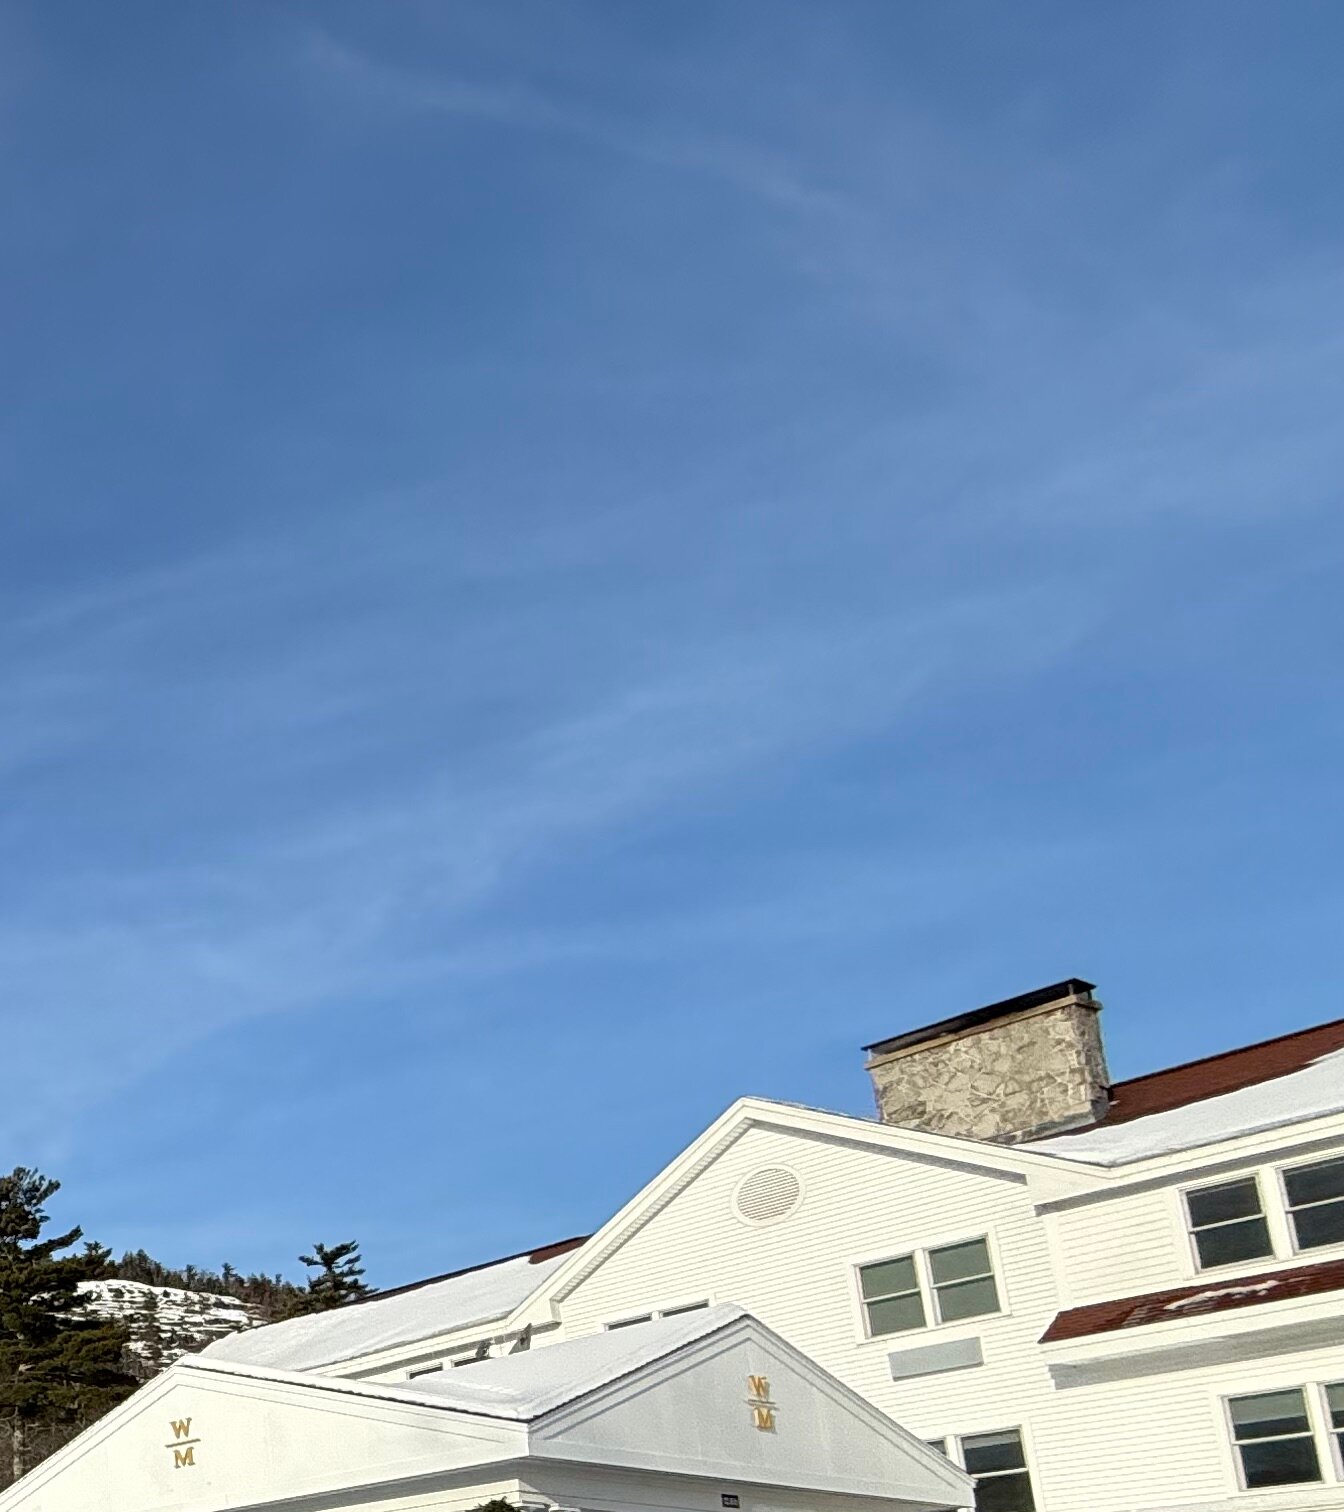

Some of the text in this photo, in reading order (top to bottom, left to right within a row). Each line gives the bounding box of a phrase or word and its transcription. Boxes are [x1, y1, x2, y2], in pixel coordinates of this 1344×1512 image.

[748, 1375, 768, 1398] W
[169, 1417, 192, 1439] W
[753, 1408, 775, 1431] M
[173, 1447, 195, 1468] M
